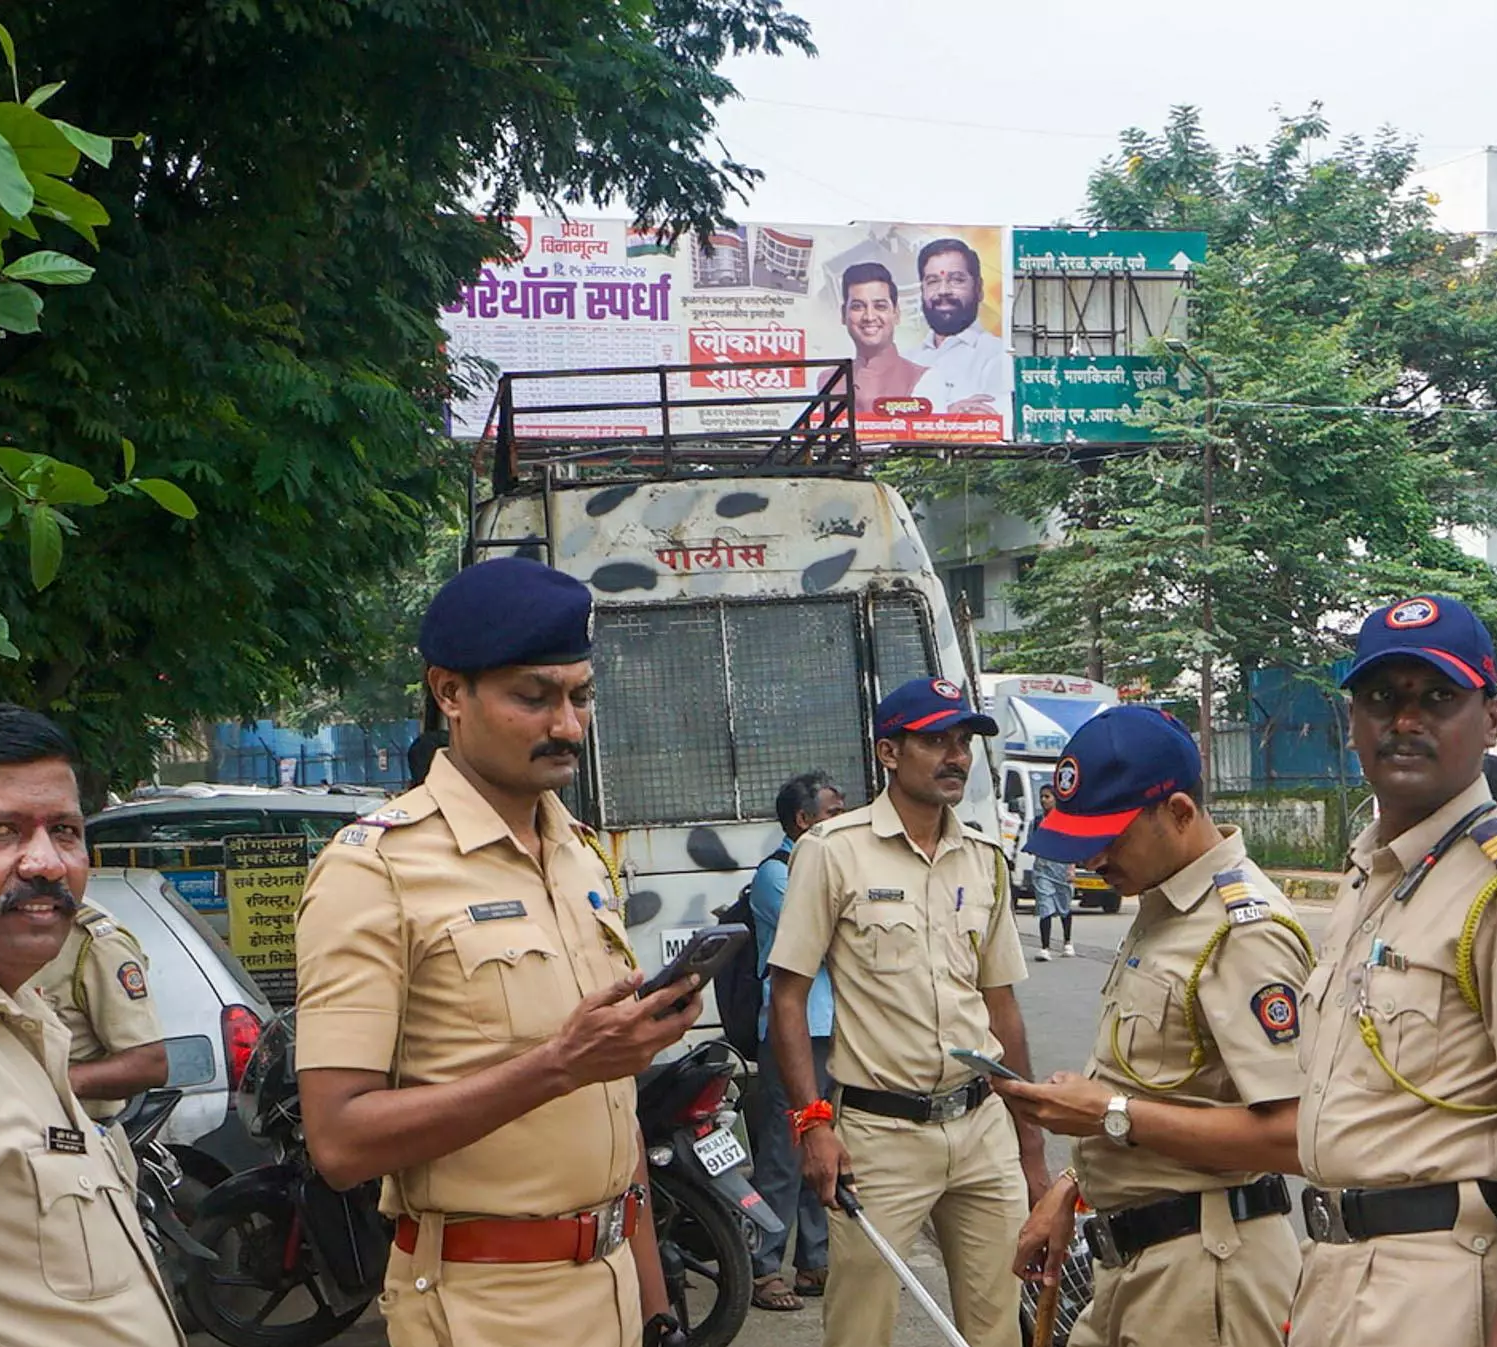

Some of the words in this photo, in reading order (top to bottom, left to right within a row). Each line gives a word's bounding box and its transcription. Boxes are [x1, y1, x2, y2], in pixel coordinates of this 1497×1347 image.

[560, 222, 594, 238] प्रवेश
[540, 235, 609, 260] विनामूल्य
[583, 273, 672, 321] स्पर्धा
[691, 321, 804, 355] लोकार्पण
[655, 532, 768, 570] पोलीस
[258, 873, 304, 889] स्टेशनरी
[270, 951, 296, 967] मिळे
[707, 1144, 741, 1172] 9157
